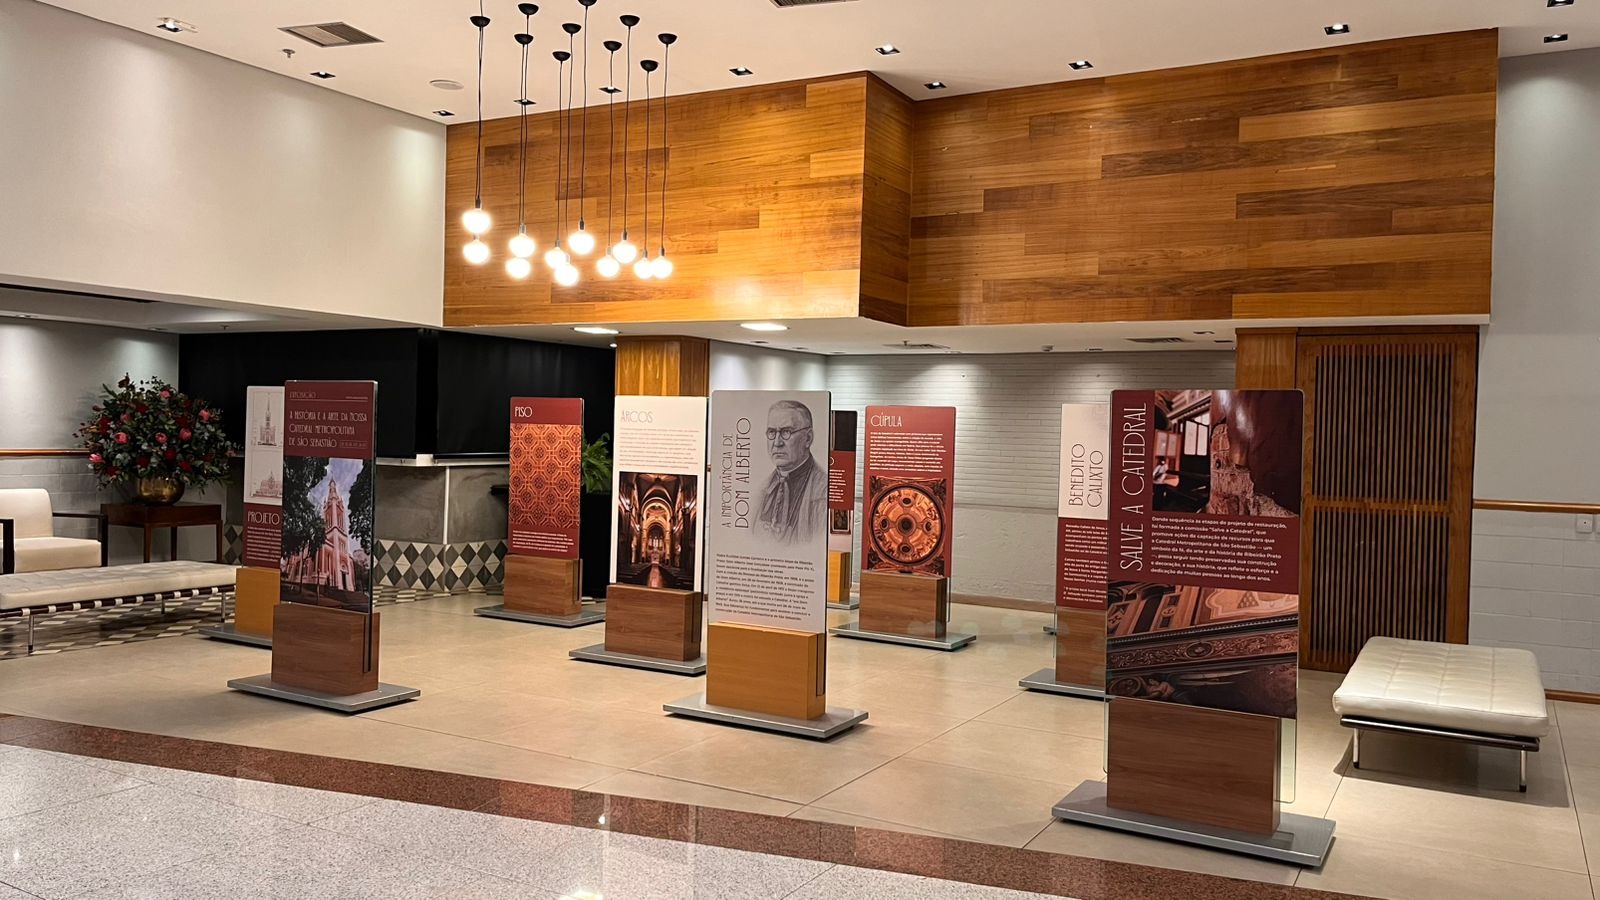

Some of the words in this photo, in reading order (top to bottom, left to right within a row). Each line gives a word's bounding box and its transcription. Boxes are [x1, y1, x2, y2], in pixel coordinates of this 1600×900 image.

[295, 410, 316, 420] HISTÓRIA
[341, 412, 348, 421] DA
[514, 406, 532, 418] PISO
[871, 412, 902, 427] CÚPULA
[297, 437, 308, 446] SÃO
[722, 434, 733, 446] DE
[736, 418, 751, 484] ALBERTO
[1121, 402, 1146, 496] CATEDRAL
[720, 451, 732, 517] IMPORTÂNCIA
[1068, 444, 1085, 506] BENEDITO
[1087, 450, 1103, 507] CALIXTO
[248, 511, 280, 525] PROJETO
[734, 490, 750, 528] DOM
[1121, 504, 1144, 514] A
[1120, 522, 1144, 571] SALVE
